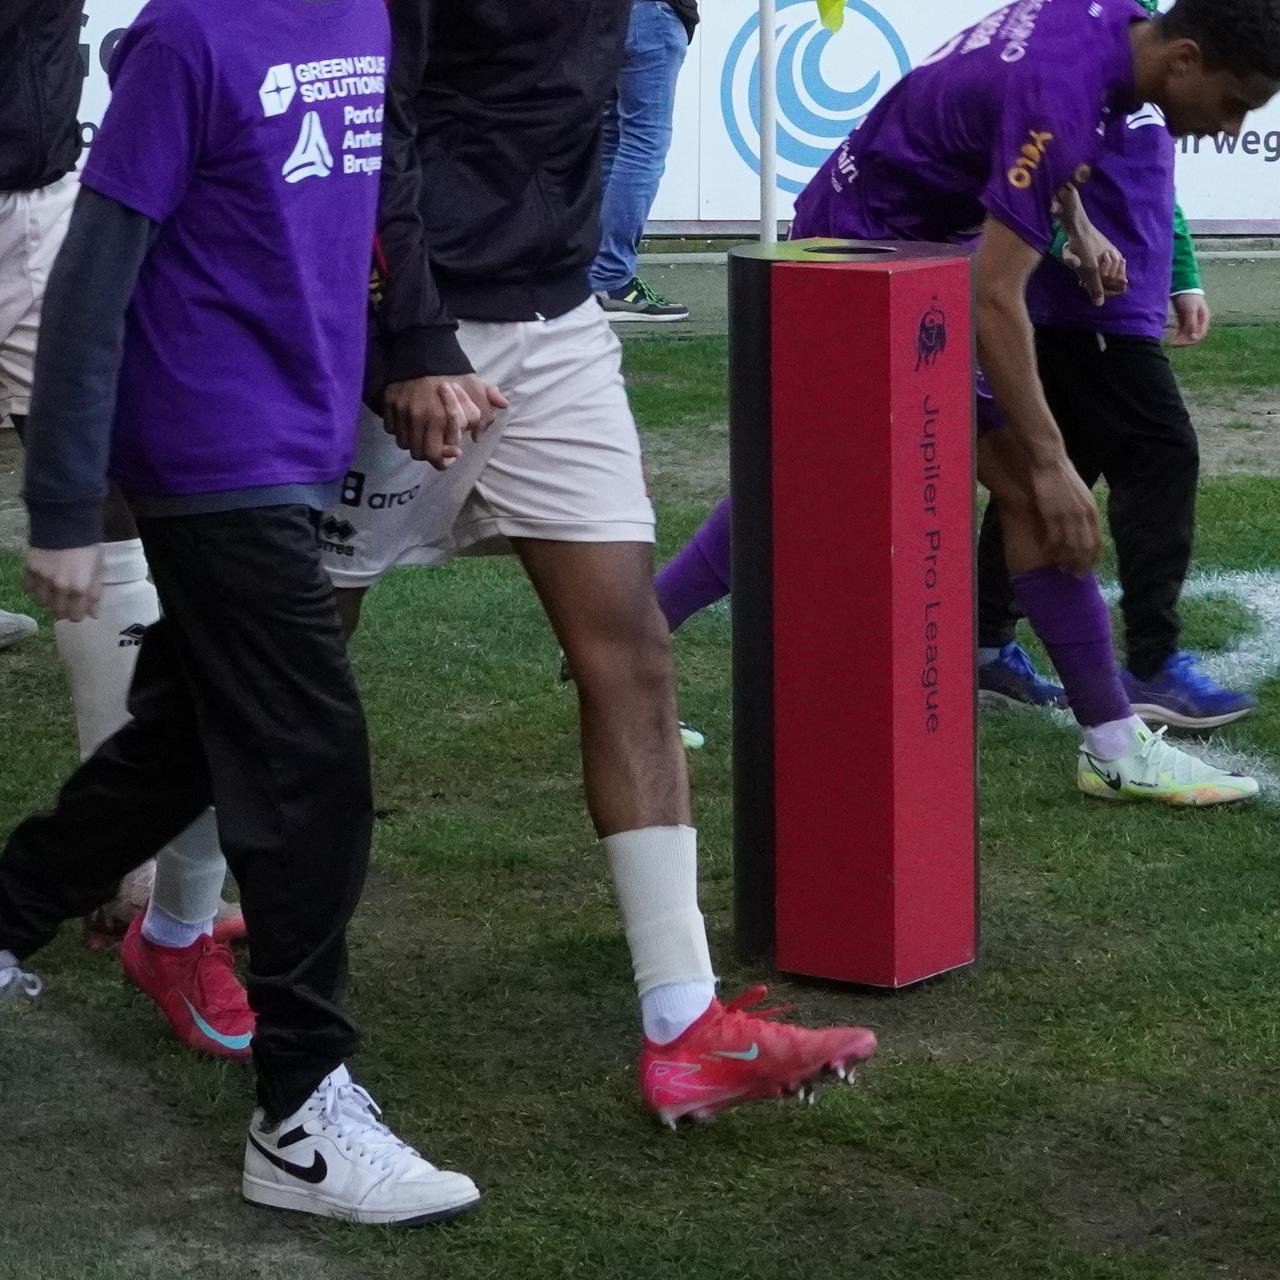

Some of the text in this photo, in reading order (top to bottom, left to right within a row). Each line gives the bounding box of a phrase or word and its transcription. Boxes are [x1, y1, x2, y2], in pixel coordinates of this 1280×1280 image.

[295, 58, 353, 83] GREEN
[344, 104, 371, 125] Port
[921, 394, 942, 736] Jupiler Pro League
